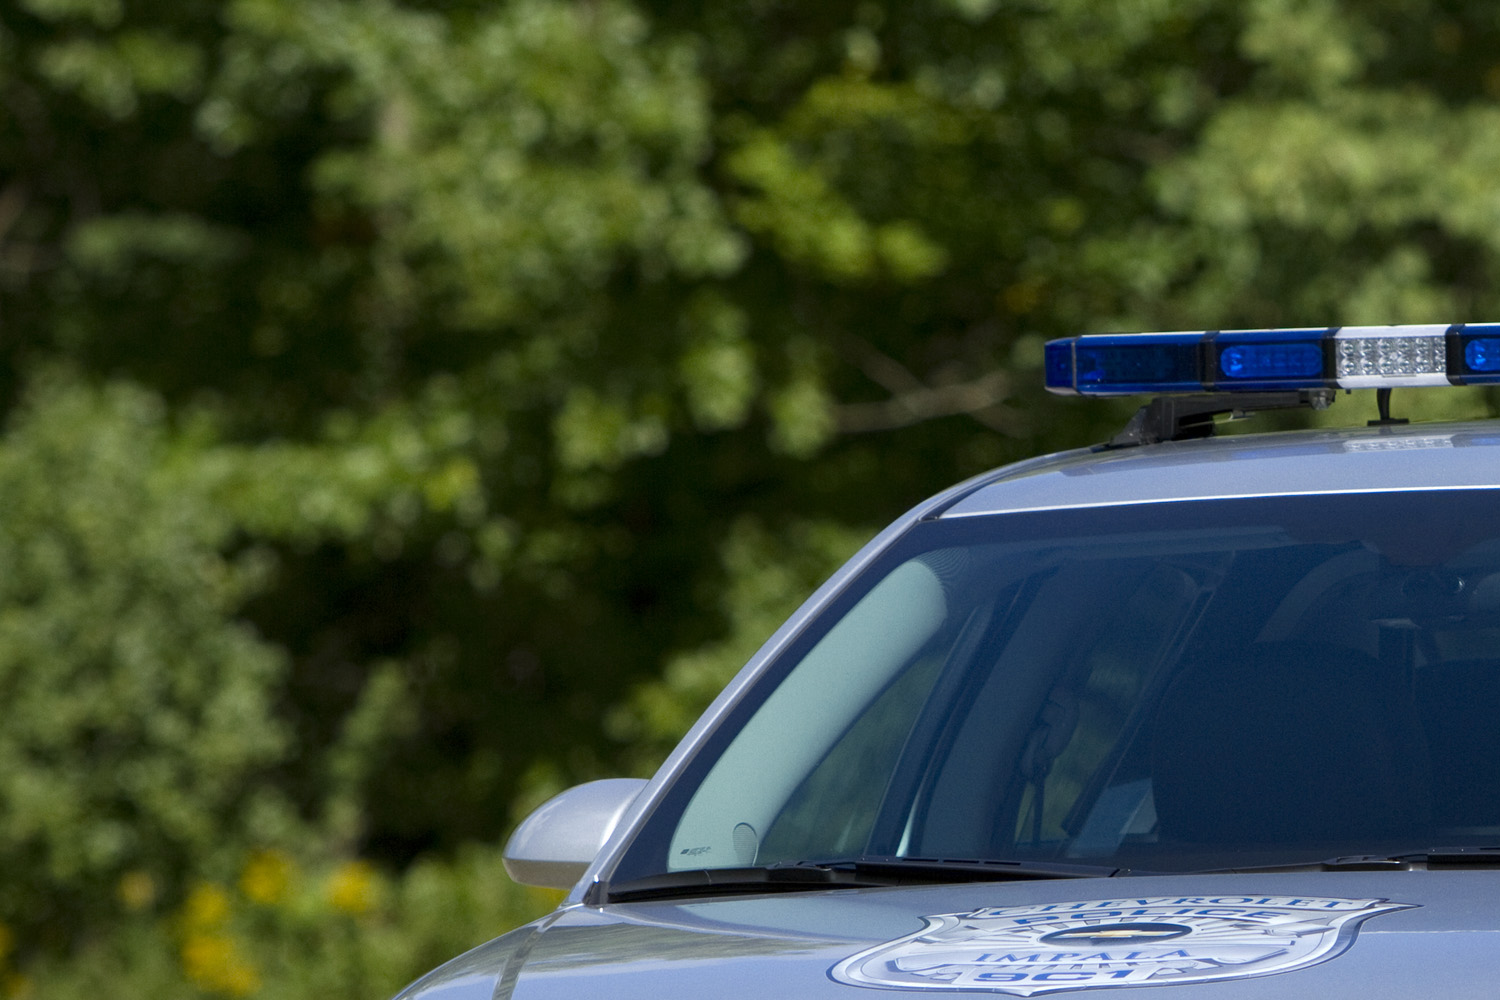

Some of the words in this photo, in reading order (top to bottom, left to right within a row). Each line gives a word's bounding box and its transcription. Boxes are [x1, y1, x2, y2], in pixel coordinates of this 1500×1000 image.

[989, 896, 1352, 916] CHEVROLET
[1015, 908, 1289, 925] POLICE
[975, 948, 1190, 964] IMPALA
[975, 969, 1131, 983] 9C1
